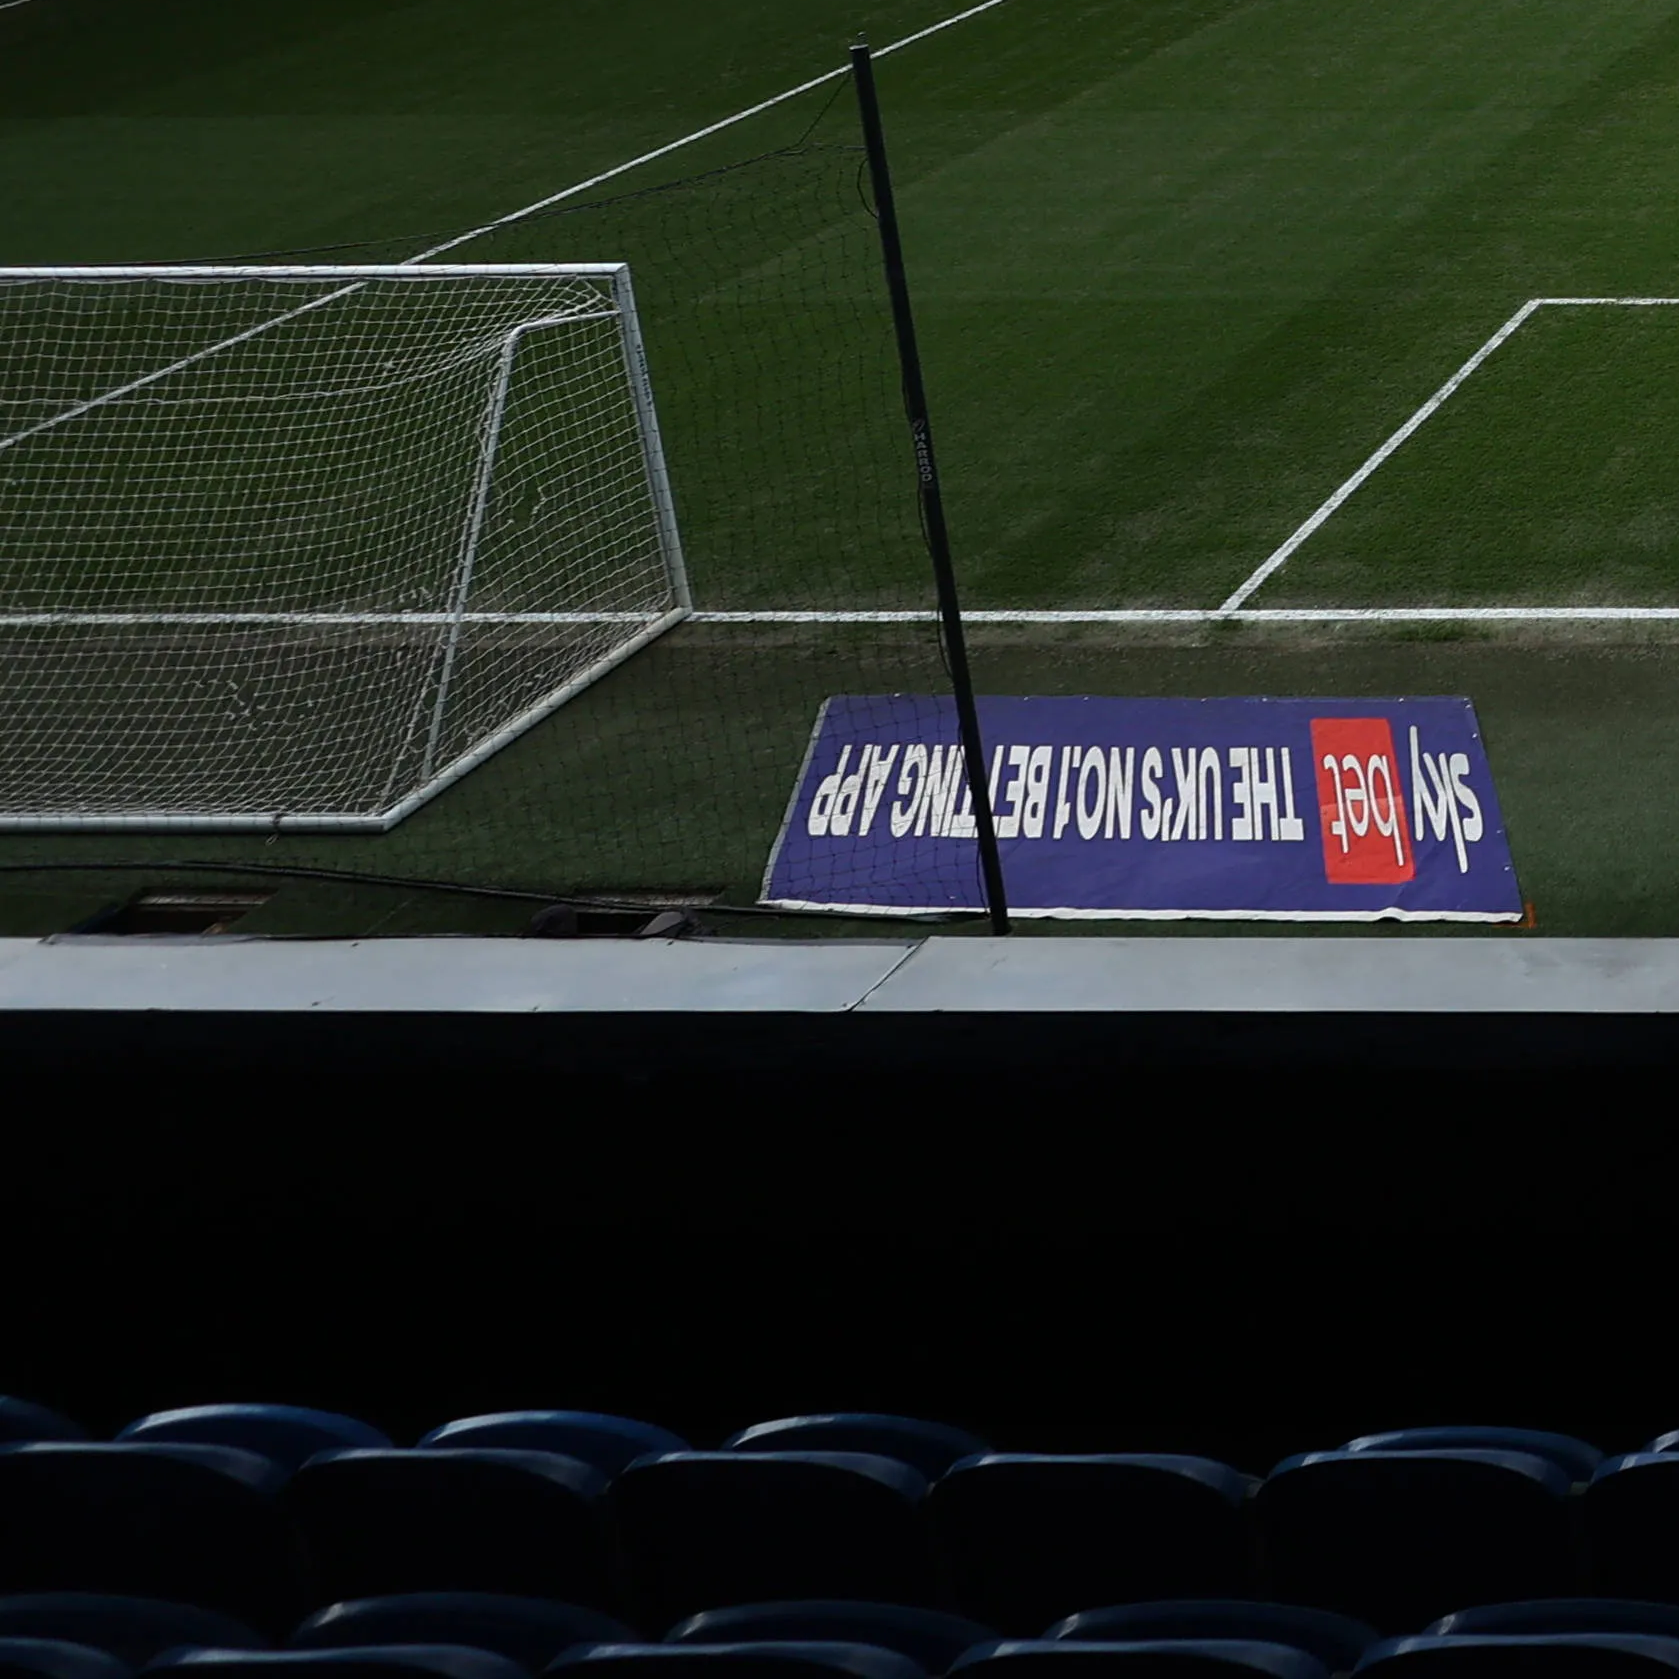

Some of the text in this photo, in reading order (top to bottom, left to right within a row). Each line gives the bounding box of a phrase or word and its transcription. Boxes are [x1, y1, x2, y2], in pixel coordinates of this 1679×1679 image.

[913, 432, 932, 482] HARROD
[807, 743, 1305, 842] THE UK'S NO.1 BETTING APP
[1322, 724, 1484, 876] sky bet
